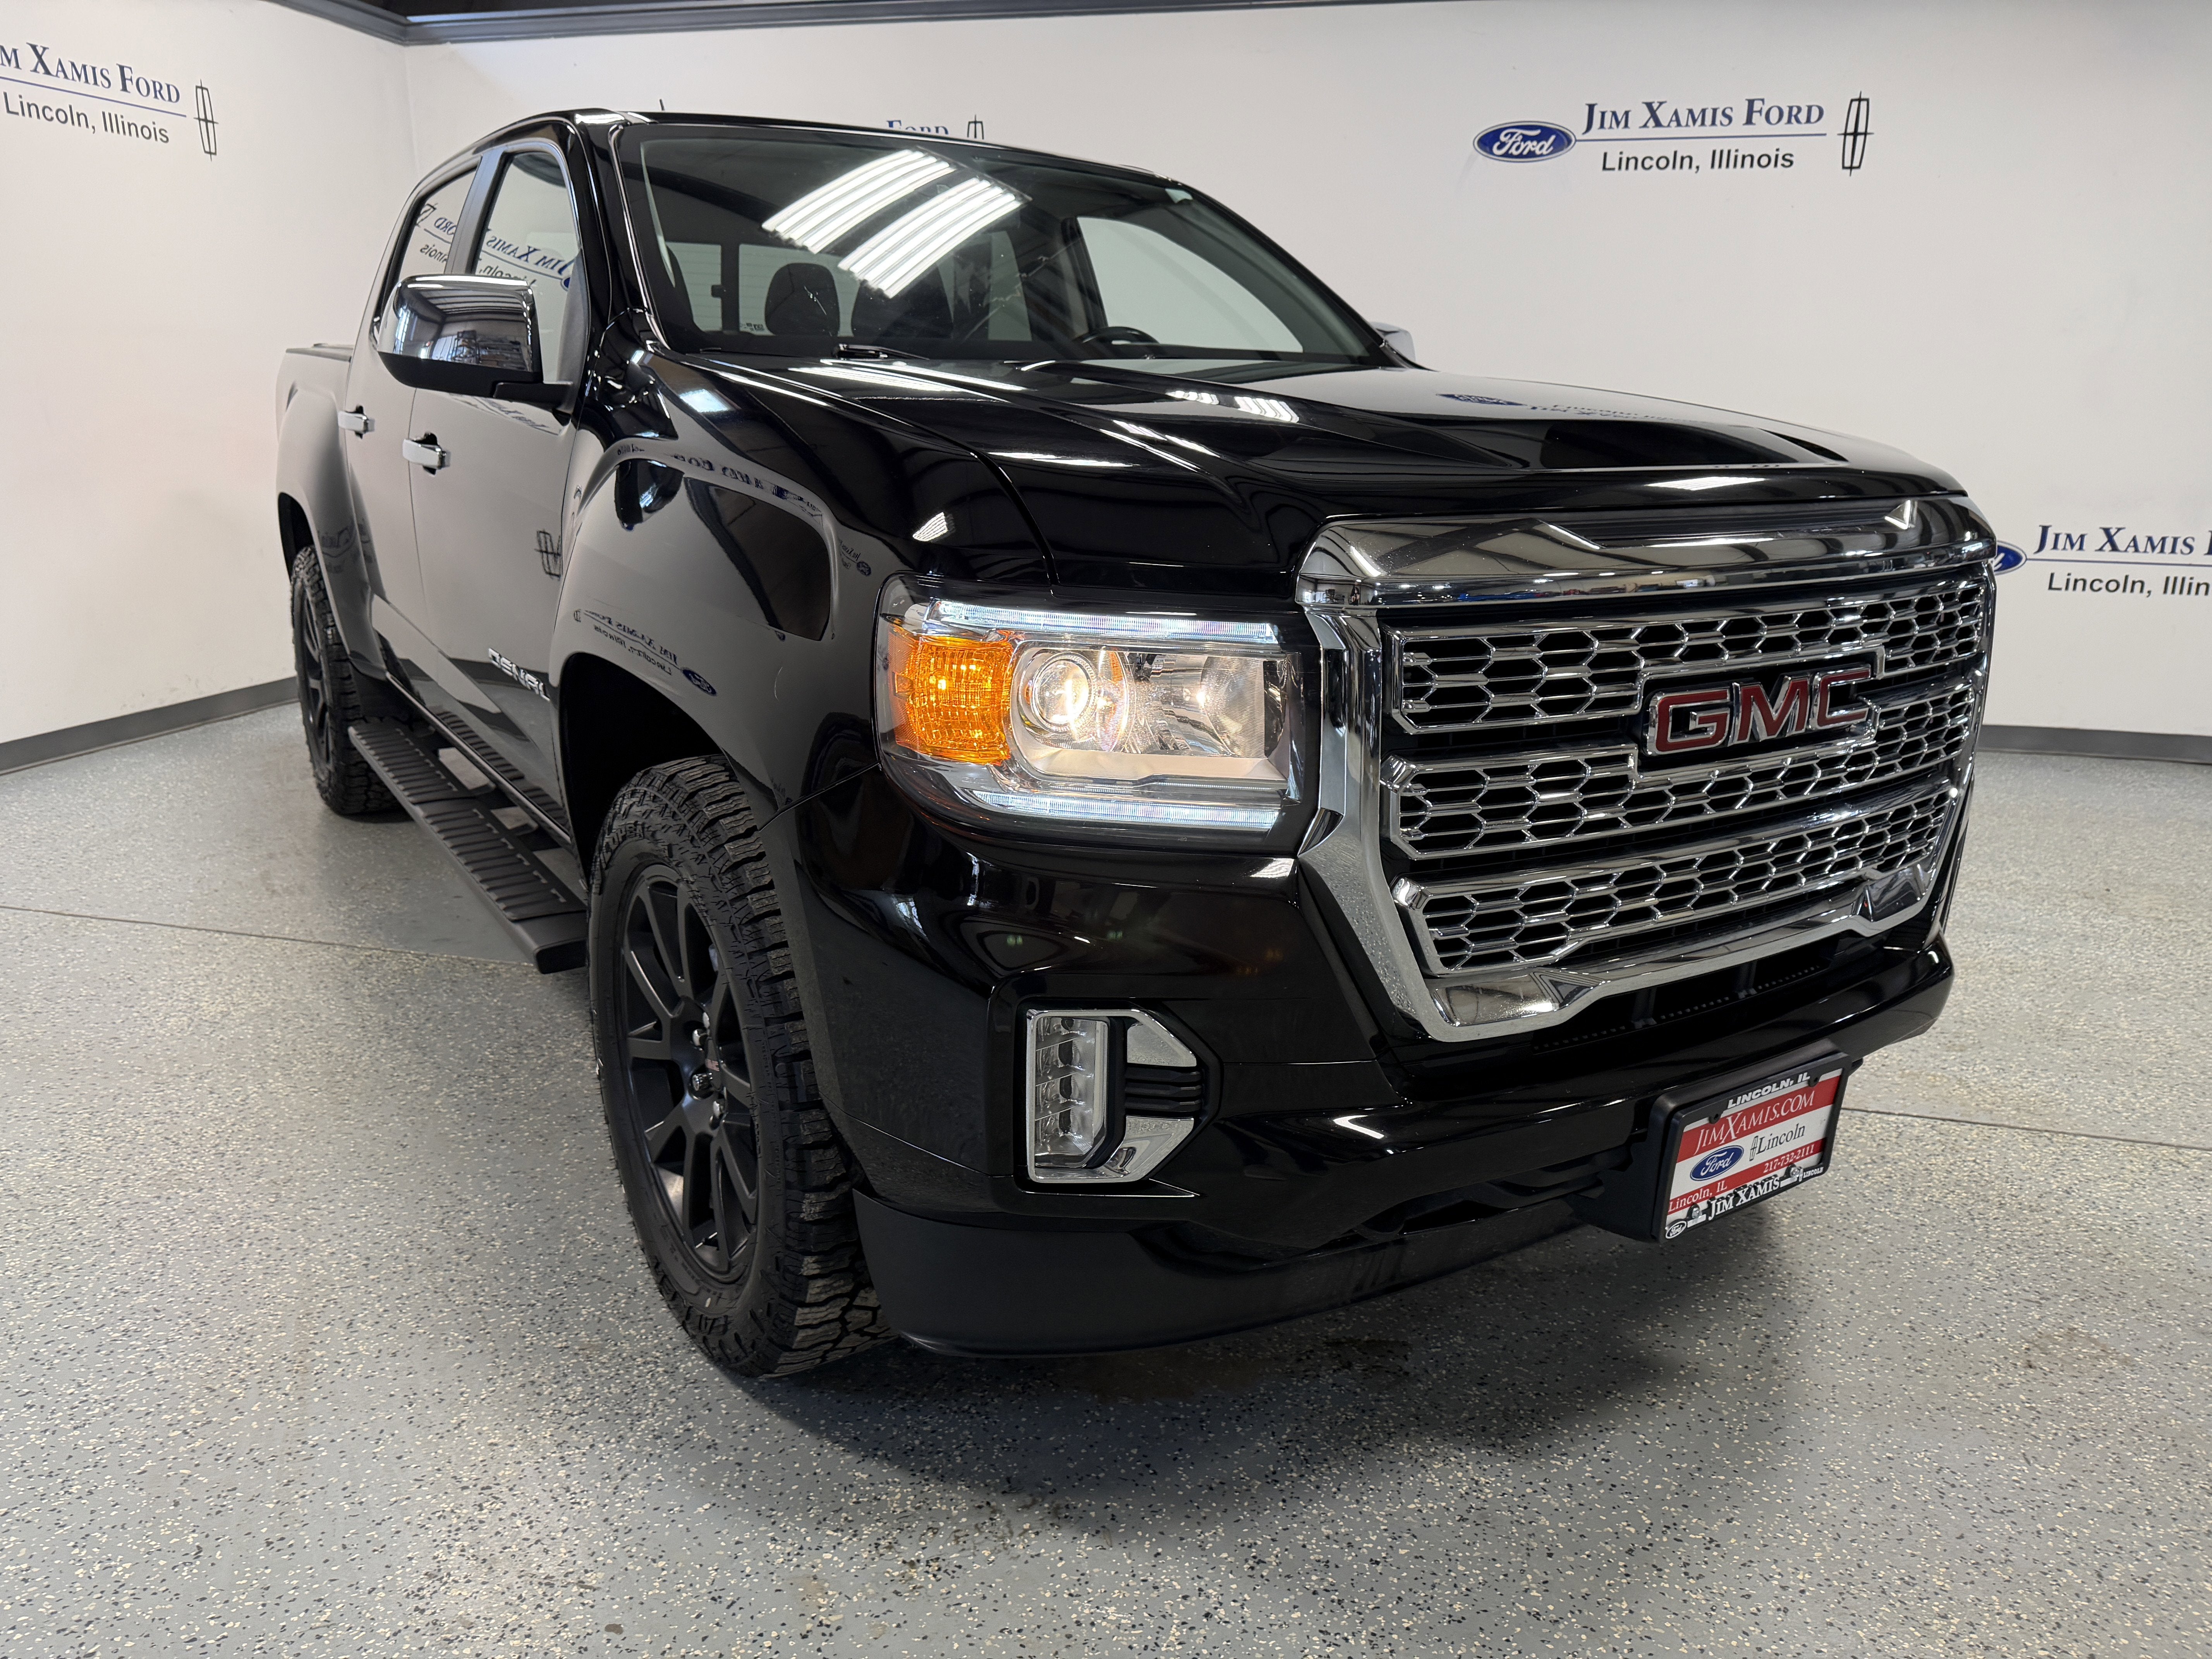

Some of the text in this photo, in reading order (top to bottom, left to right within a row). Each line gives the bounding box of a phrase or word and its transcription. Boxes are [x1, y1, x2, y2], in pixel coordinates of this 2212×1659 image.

[26, 42, 112, 89] XAMIS
[116, 63, 180, 103] FORD
[3, 91, 170, 144] Lincoln, Illinois
[1582, 98, 1824, 135] JIM XAMIS FORD
[1492, 128, 1557, 156] Ford
[1602, 148, 1794, 174] Lincoln, Illinois
[2033, 524, 2088, 554] JIM
[2095, 526, 2195, 556] XAMIS
[2047, 572, 2152, 598] Lincoln,
[1647, 663, 1871, 756] GMC
[1728, 1072, 1810, 1109] LINCOLN, IL
[1693, 1091, 1815, 1156] JIMXAMIS.COM
[1756, 1123, 1805, 1155] Lincoln
[1700, 1152, 1734, 1176] Ford
[1763, 1144, 1815, 1173] 217-732-2111
[1669, 1180, 1727, 1212] Lincoln, IL
[1709, 1176, 1780, 1221] JIM XAMIS
